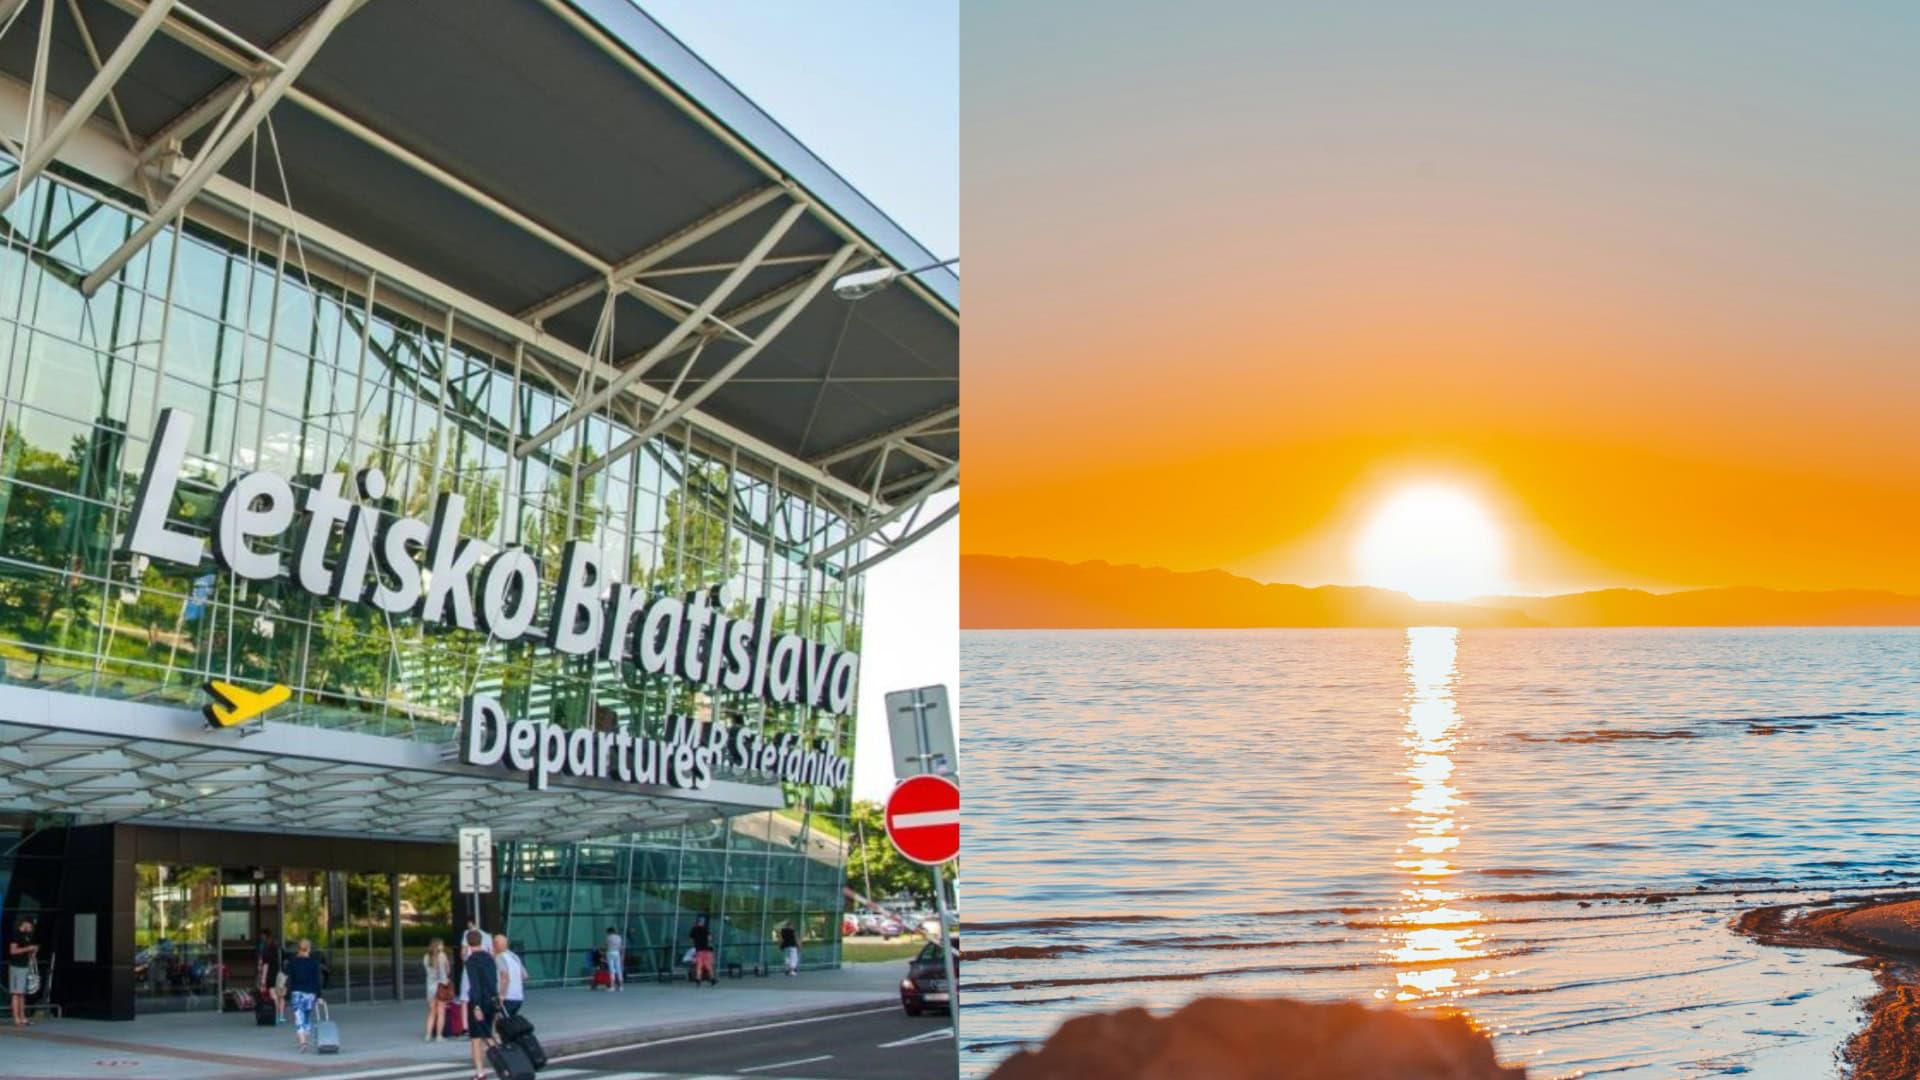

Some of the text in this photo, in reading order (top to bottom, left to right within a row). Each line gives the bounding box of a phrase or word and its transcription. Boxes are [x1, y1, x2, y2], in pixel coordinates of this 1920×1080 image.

[126, 407, 859, 716] Letisko Bratislava
[467, 694, 711, 791] Departures
